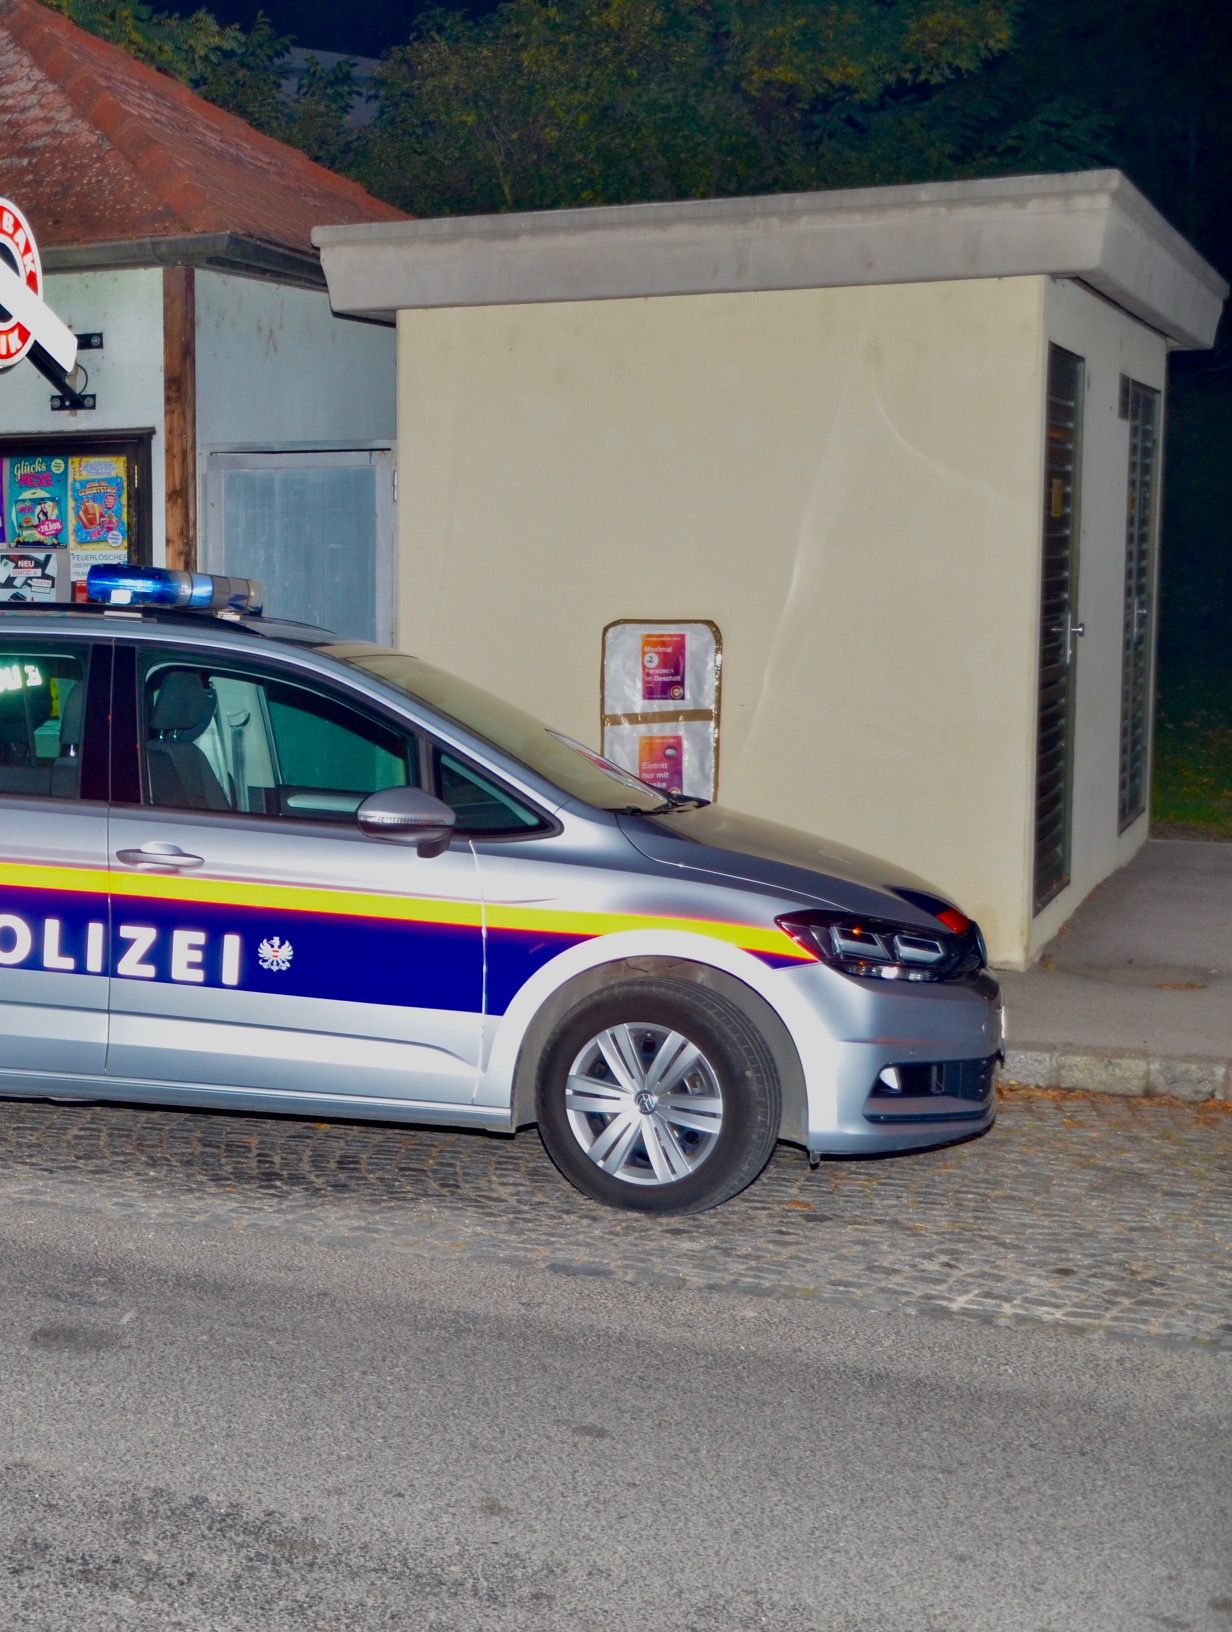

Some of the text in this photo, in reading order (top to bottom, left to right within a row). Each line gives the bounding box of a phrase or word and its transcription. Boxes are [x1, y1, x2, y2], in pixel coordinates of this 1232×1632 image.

[14, 457, 47, 481] Glücks
[19, 472, 53, 488] HEXE
[17, 560, 35, 568] NEU
[644, 645, 673, 653] Maximal
[653, 674, 681, 682] Geschäft
[656, 771, 670, 779] mit
